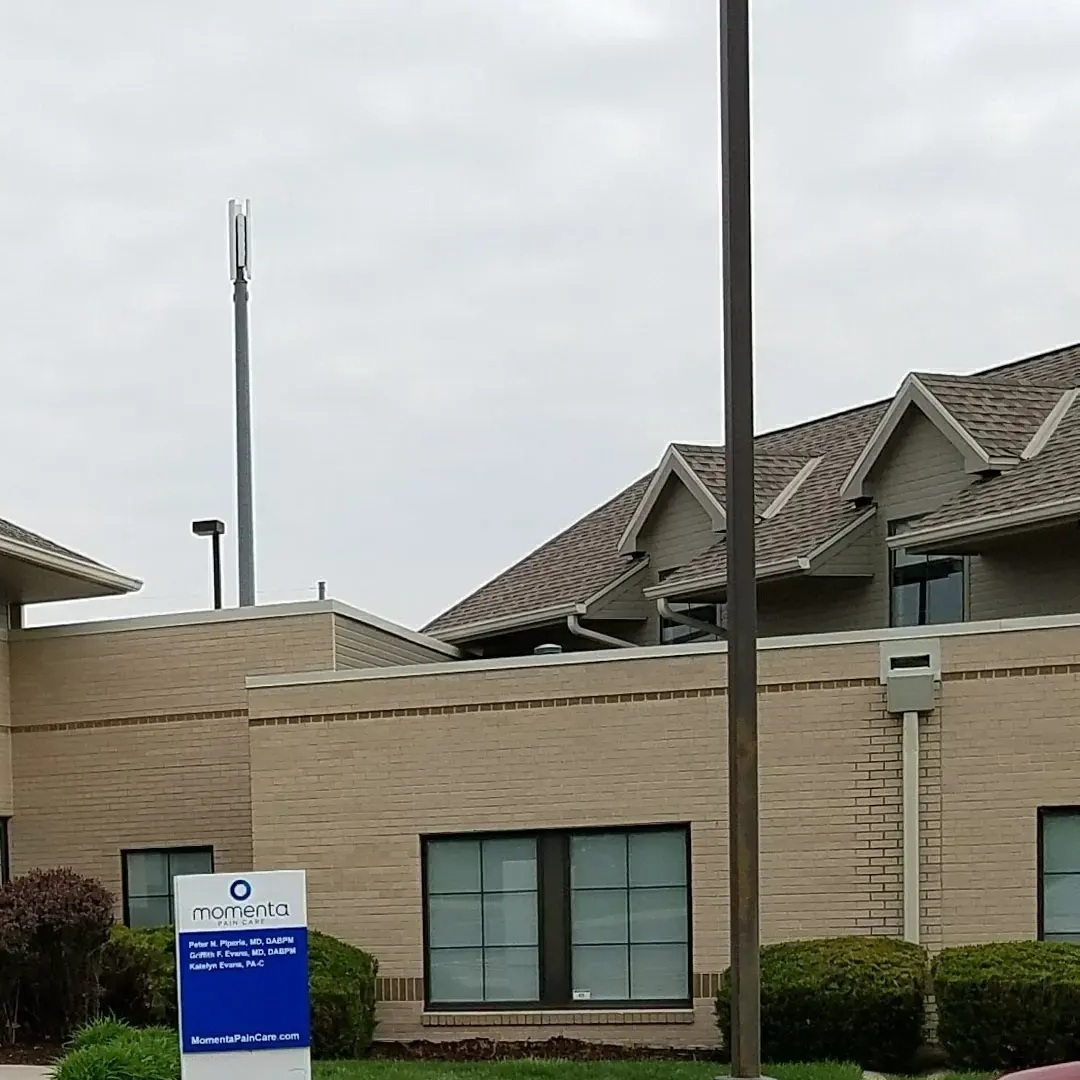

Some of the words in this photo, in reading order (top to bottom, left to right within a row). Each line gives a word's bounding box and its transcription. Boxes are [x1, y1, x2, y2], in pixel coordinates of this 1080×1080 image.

[193, 901, 290, 920] momenta
[188, 941, 209, 949] Peter
[250, 938, 264, 947] MD,
[251, 948, 266, 957] MD,
[189, 962, 217, 971] Katelyn
[246, 960, 264, 968] PA-C
[191, 1033, 300, 1045] MomentaPainCare.com
